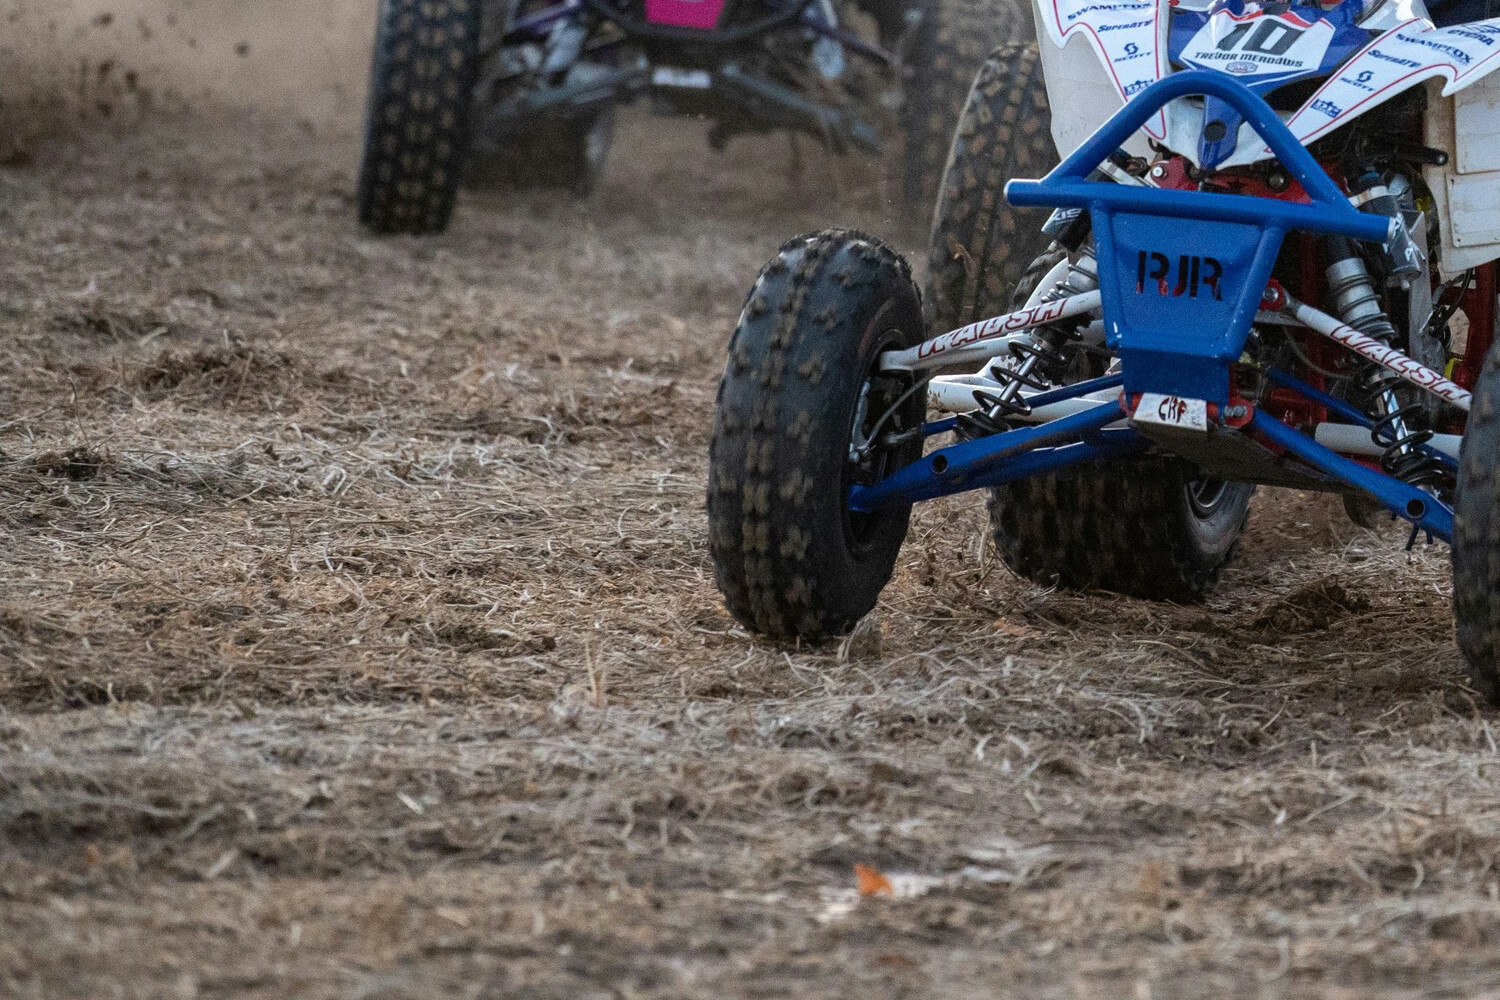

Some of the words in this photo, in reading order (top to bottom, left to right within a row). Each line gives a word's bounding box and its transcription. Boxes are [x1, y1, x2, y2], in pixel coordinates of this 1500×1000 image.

[1195, 51, 1237, 60] TREVOR
[1240, 53, 1304, 67] MEADOWS
[1215, 18, 1306, 56] 10
[1395, 33, 1475, 64] SWAMPFOX
[1136, 251, 1224, 301] RJR
[918, 299, 1068, 359] WALSH
[1330, 323, 1472, 401] WALSH
